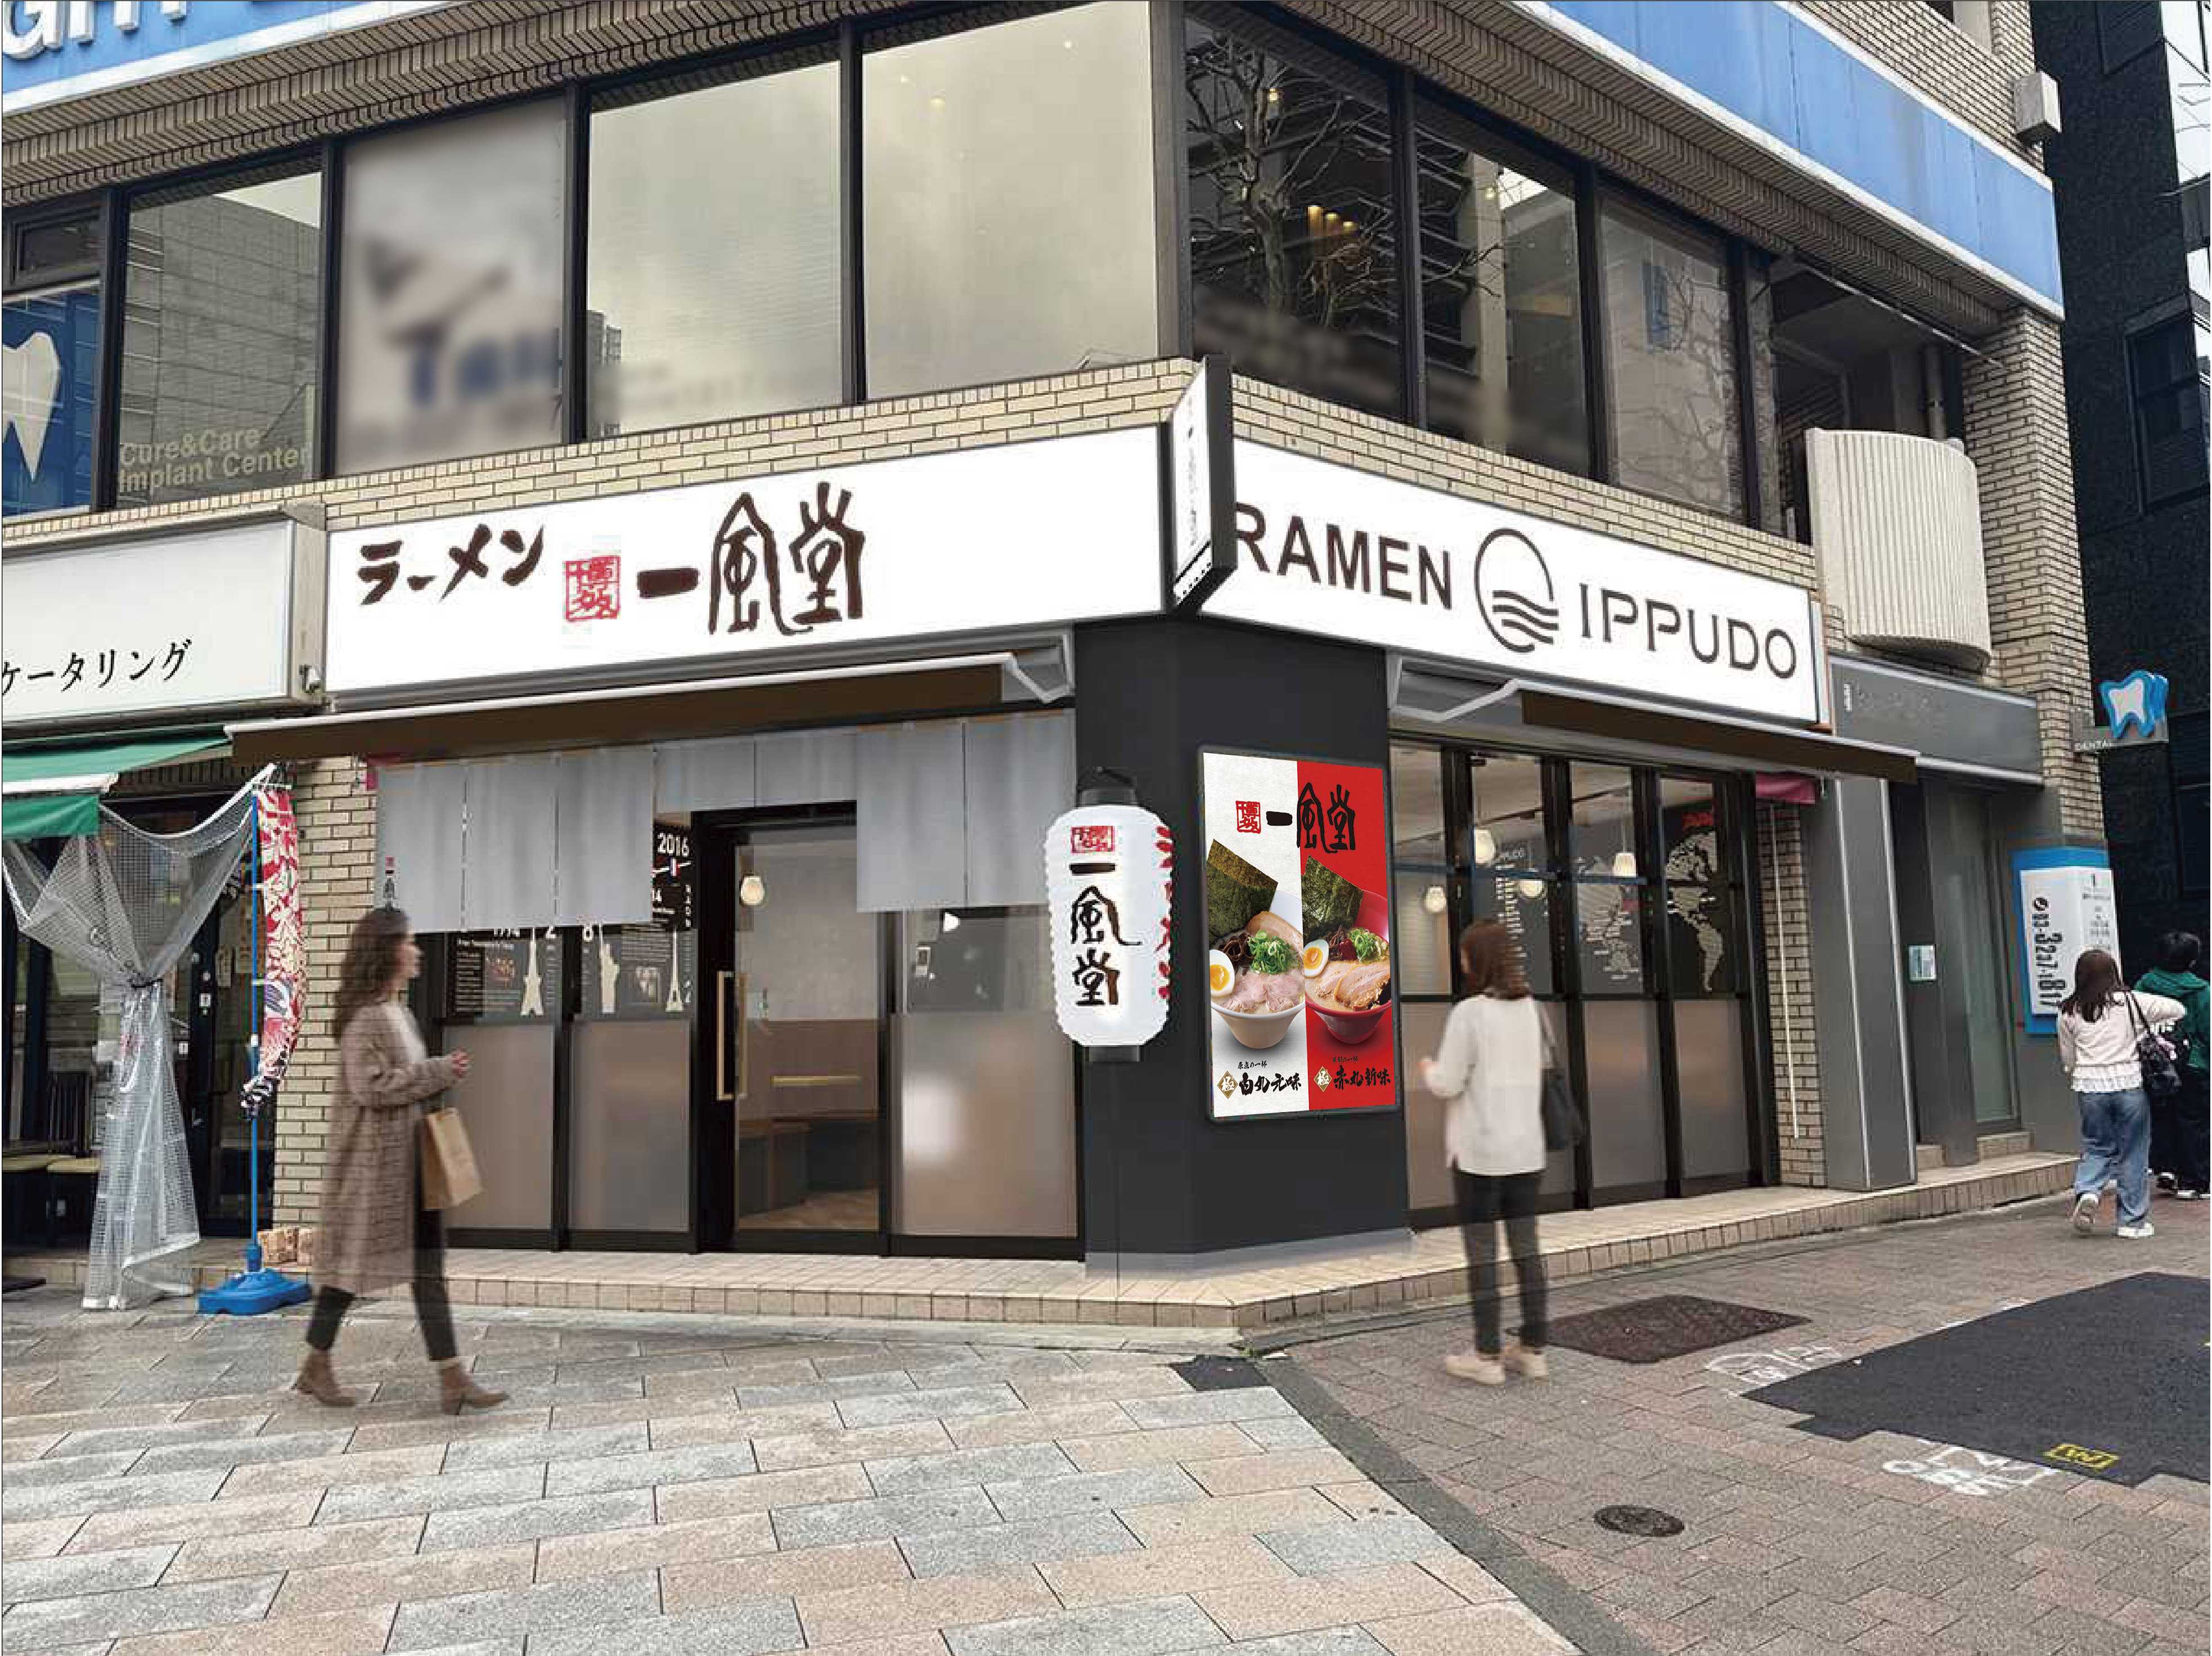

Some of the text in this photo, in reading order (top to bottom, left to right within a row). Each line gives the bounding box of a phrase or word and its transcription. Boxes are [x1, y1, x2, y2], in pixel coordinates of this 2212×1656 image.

[224, 444, 311, 478] Center
[357, 524, 543, 605] ラーメン
[637, 482, 866, 636] 一風堂
[1236, 502, 1797, 680] RAMEN IPPUDO
[2, 639, 192, 696] ケータリング
[657, 832, 690, 858] 2016
[1266, 782, 1356, 852] 一風堂
[1068, 862, 1143, 1007] 一風堂
